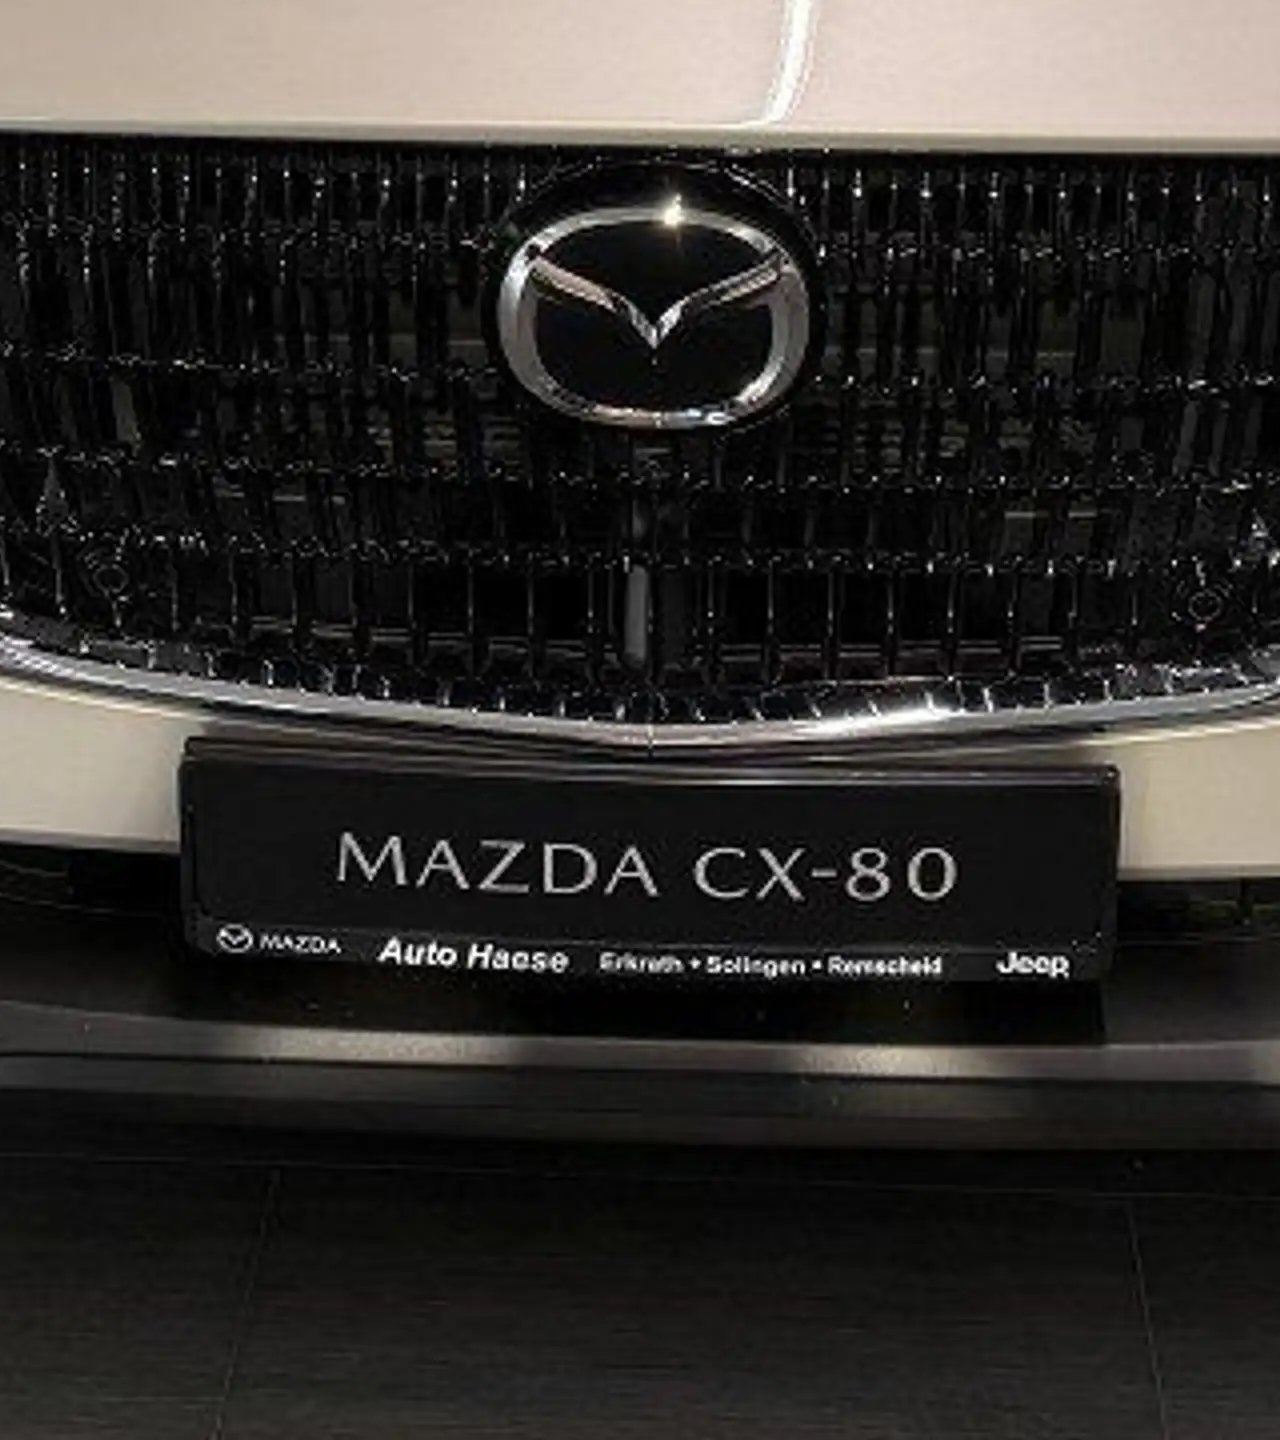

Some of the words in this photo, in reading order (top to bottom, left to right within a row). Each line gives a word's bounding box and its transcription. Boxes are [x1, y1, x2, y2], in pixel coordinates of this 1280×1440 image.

[336, 831, 660, 898] MAZDA
[692, 847, 958, 901] CX-80
[259, 933, 342, 954] MAZDA
[376, 935, 458, 967] Auto
[706, 955, 807, 980] Solingen
[827, 955, 943, 977] Remscheid
[996, 951, 1070, 978] Jeep
